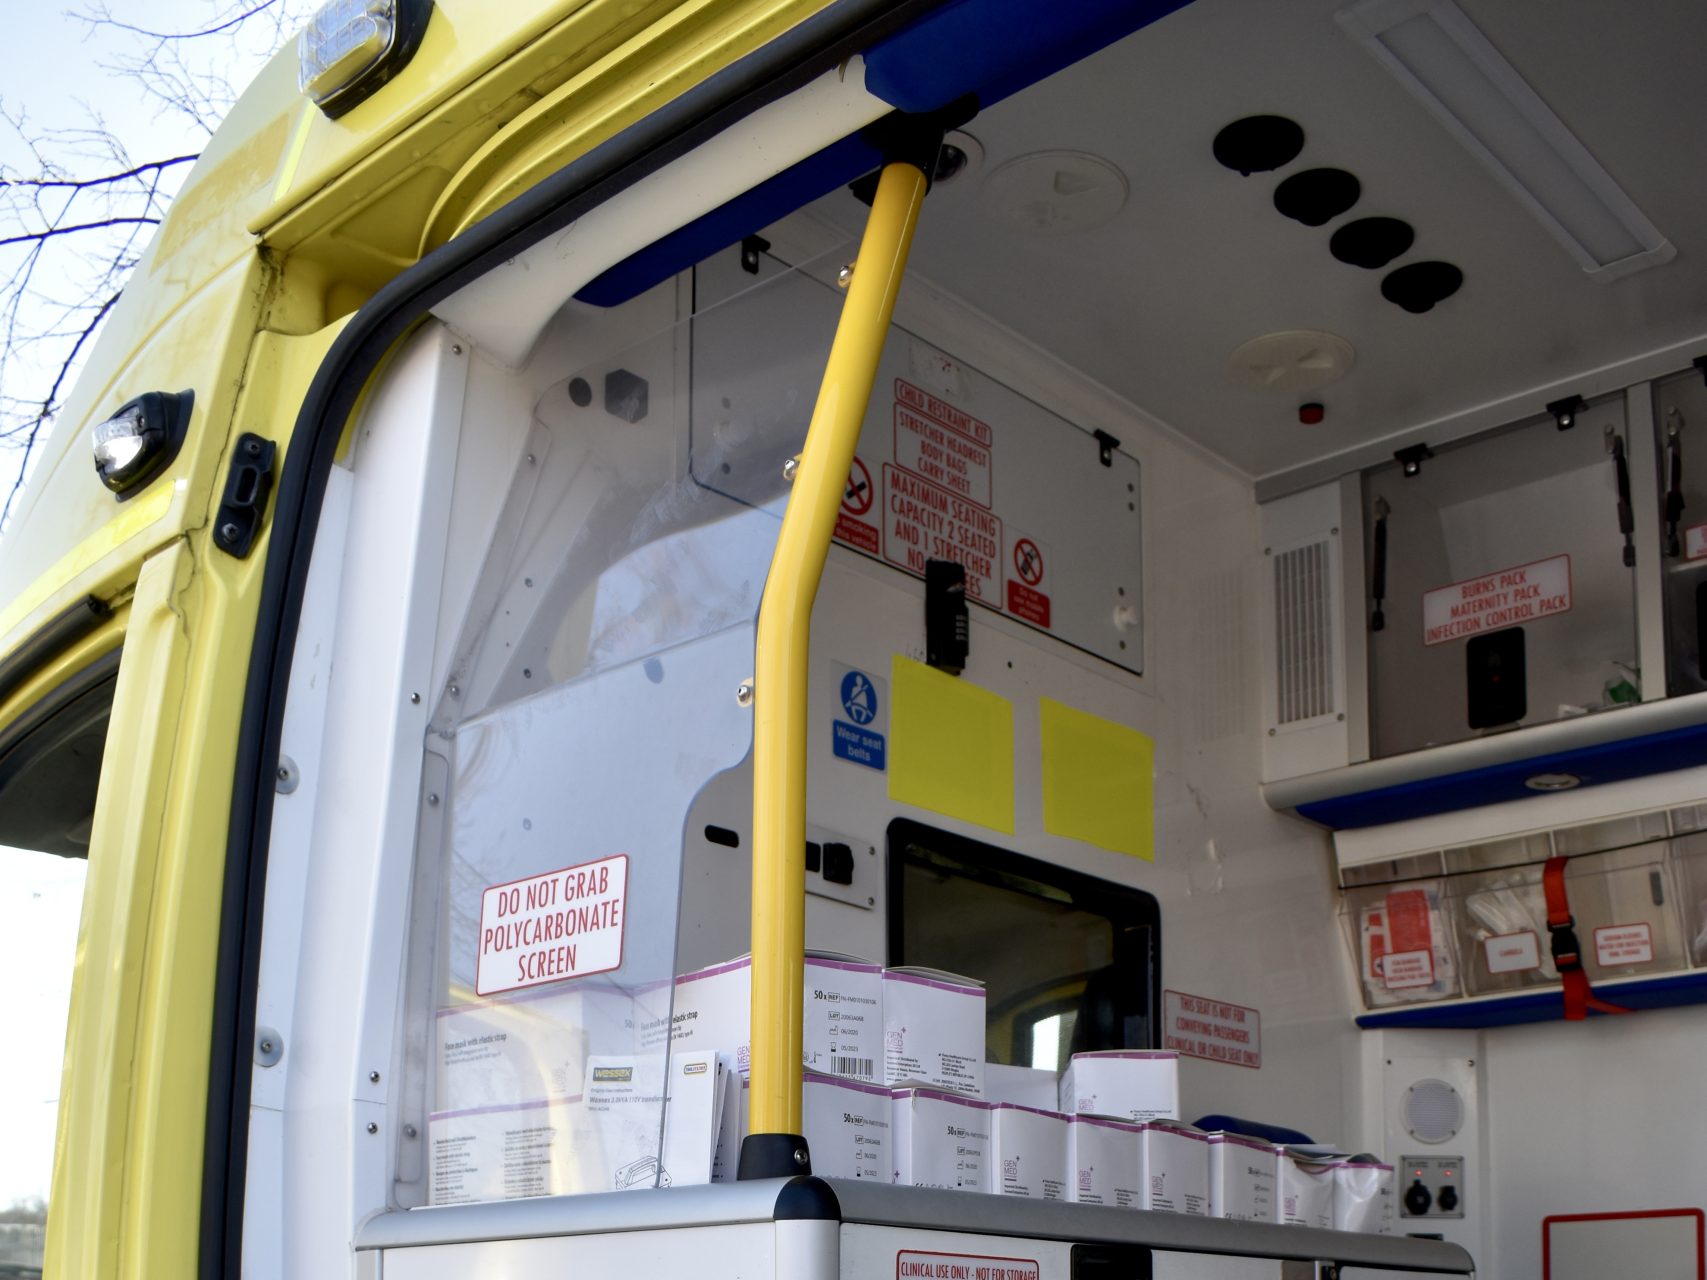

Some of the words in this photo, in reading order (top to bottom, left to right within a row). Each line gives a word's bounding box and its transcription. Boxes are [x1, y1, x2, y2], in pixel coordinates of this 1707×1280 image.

[900, 384, 923, 408] CHILD
[928, 399, 970, 432] RESTRAINT
[976, 422, 987, 441] KIT
[900, 411, 944, 445] STRETCHER
[947, 436, 986, 467] HEADREST
[921, 441, 942, 462] BODY
[946, 453, 967, 475] BAGS
[918, 457, 944, 482] CARRY
[947, 471, 970, 493] SHEET
[891, 472, 948, 514] MAXIMUM
[952, 500, 995, 536] SEATING
[891, 494, 944, 534] CAPACITY
[948, 521, 954, 539] 2
[958, 525, 995, 558] SEATED
[895, 520, 919, 545] AND
[934, 536, 991, 580] STRETCHER
[907, 547, 924, 571] NO
[1462, 578, 1495, 599] BURNS
[1500, 570, 1527, 588] PACK
[1450, 592, 1509, 618] MATERNITY
[1514, 584, 1540, 602] PACK
[1427, 616, 1480, 642] INFECTION
[1486, 603, 1534, 626] CONTROL
[1540, 594, 1567, 613] PACK
[837, 725, 860, 743] Wear
[863, 736, 881, 751] seat
[848, 744, 871, 761] belts
[498, 888, 520, 918] DO
[526, 878, 559, 911] NOT
[565, 866, 609, 901] GRAB
[484, 899, 619, 954] POLYCARBONATE
[518, 944, 576, 982] SCREEN
[673, 1013, 686, 1024] elastic
[687, 1010, 698, 1020] strap
[1180, 996, 1194, 1012] THIS
[1196, 1000, 1210, 1015] SEAT
[1212, 1004, 1218, 1017] IS
[1220, 1006, 1232, 1020] NOT
[1233, 1008, 1245, 1022] FOR
[887, 1031, 903, 1039] GEN
[1177, 1016, 1212, 1036] CONVEYING
[1214, 1024, 1249, 1044] PASSENGERS
[737, 1047, 750, 1055] GEN
[1167, 1035, 1196, 1053] CLINICAL
[1209, 1043, 1226, 1058] CHILD
[1228, 1047, 1241, 1061] SEAT
[1004, 1160, 1017, 1168] GEN
[1079, 1170, 1091, 1178] GEN
[901, 1262, 934, 1278] CLINICAL
[936, 1264, 949, 1279] USE
[951, 1265, 970, 1280] ONLY
[975, 1267, 990, 1280] NOT
